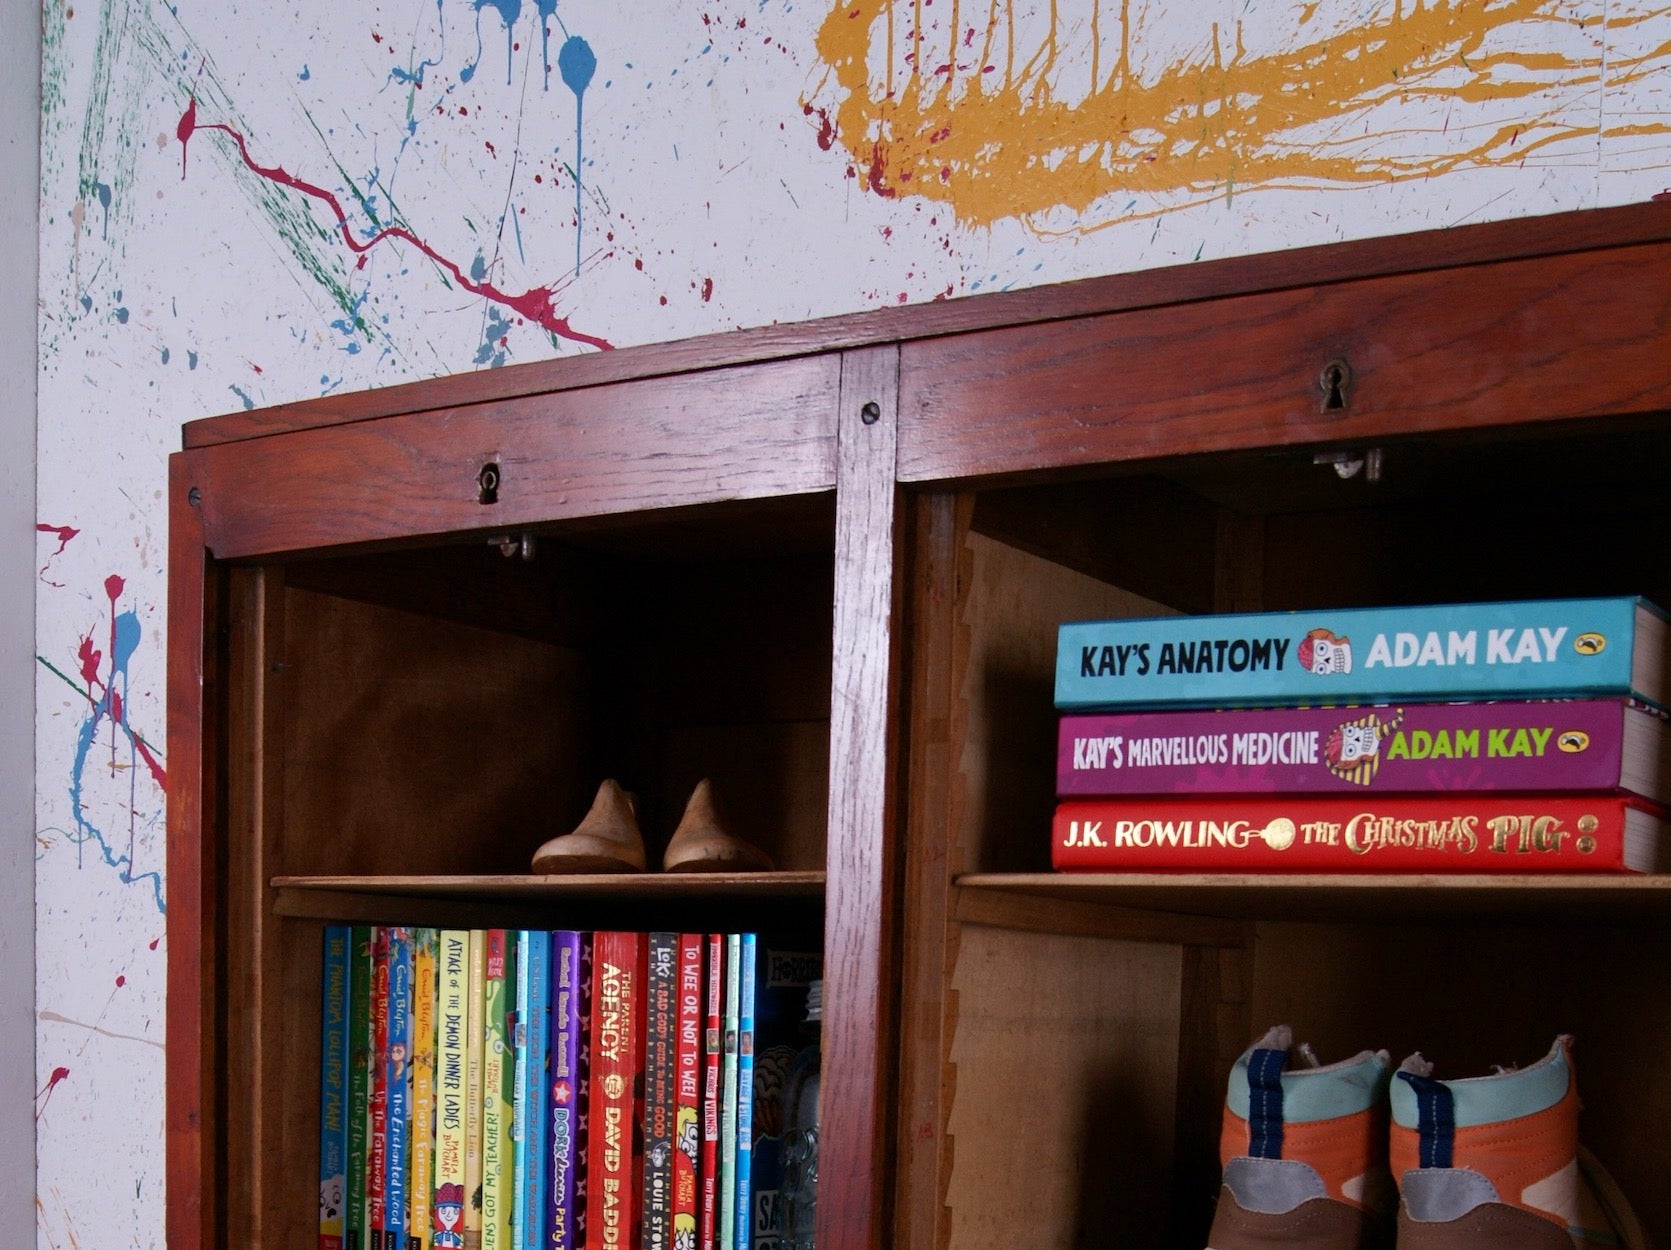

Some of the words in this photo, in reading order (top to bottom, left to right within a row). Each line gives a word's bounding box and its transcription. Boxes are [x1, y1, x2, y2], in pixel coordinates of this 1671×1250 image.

[1081, 642, 1150, 677] KAY'S
[1157, 638, 1290, 675] ANATOMY
[1365, 630, 1477, 668] ADAM
[1486, 627, 1568, 665] KAY
[1073, 736, 1123, 770] KAY'S
[1128, 734, 1228, 767] MARVELLOUS
[1231, 731, 1319, 765] MEDICINE
[1386, 729, 1480, 760] ADAM
[1487, 727, 1554, 757] KAY
[1063, 821, 1108, 848] J.K.
[1115, 820, 1251, 848] ROWLING
[1300, 821, 1341, 846] THE
[1486, 815, 1571, 855] PIG
[329, 937, 344, 957] THE
[327, 963, 345, 1025] PHANTOM
[377, 964, 389, 994] Enid
[395, 964, 407, 995] Enid
[421, 967, 431, 998] Enid
[620, 972, 632, 998] THE
[683, 964, 699, 992] WEE
[375, 998, 388, 1035] Blyton
[392, 998, 406, 1037] Blyton
[448, 994, 460, 1010] THE
[599, 962, 622, 1064] AGENCY
[656, 990, 669, 1011] BAD
[683, 995, 699, 1016] OR
[419, 1002, 431, 1041] Blyton
[444, 1013, 462, 1050] DEMON
[619, 1002, 631, 1055] PARENT
[682, 1020, 698, 1047] NOT
[326, 1029, 343, 1089] LOLLIPOP
[444, 1053, 461, 1091] DINNER
[470, 1060, 478, 1080] The
[656, 1043, 668, 1068] GUIDE
[655, 1080, 666, 1104] BEING
[680, 1068, 697, 1098] WEE!
[324, 1092, 342, 1132] MAN!
[374, 1109, 386, 1129] The
[392, 1093, 403, 1115] The
[416, 1097, 429, 1139] Magic
[443, 1094, 461, 1130] LADIES
[468, 1083, 478, 1130] Butterfly
[705, 1102, 717, 1136] VIKINGS
[486, 1112, 500, 1164] TEACHER!
[654, 1106, 667, 1138] GOOD
[390, 1116, 404, 1187] Enchanted
[441, 1134, 452, 1179] BUTCHART
[468, 1134, 476, 1158] Lion
[604, 1106, 622, 1173] DAVID
[371, 1132, 385, 1191] Faraway
[414, 1142, 427, 1199] Faraway
[450, 1140, 459, 1174] PAMELA
[350, 1151, 362, 1198] Faraway
[486, 1170, 498, 1188] MY
[652, 1172, 664, 1211] LOUIE
[677, 1170, 688, 1207] BUTCHART
[686, 1175, 695, 1204] PAMELA
[705, 1178, 714, 1193] Terry
[351, 1202, 361, 1228] Tree
[371, 1196, 383, 1222] Tree
[390, 1190, 402, 1225] Wood
[415, 1205, 426, 1232] Tree
[485, 1192, 497, 1218] GOT
[704, 1194, 714, 1212] Deary
[552, 1207, 567, 1243] Party
